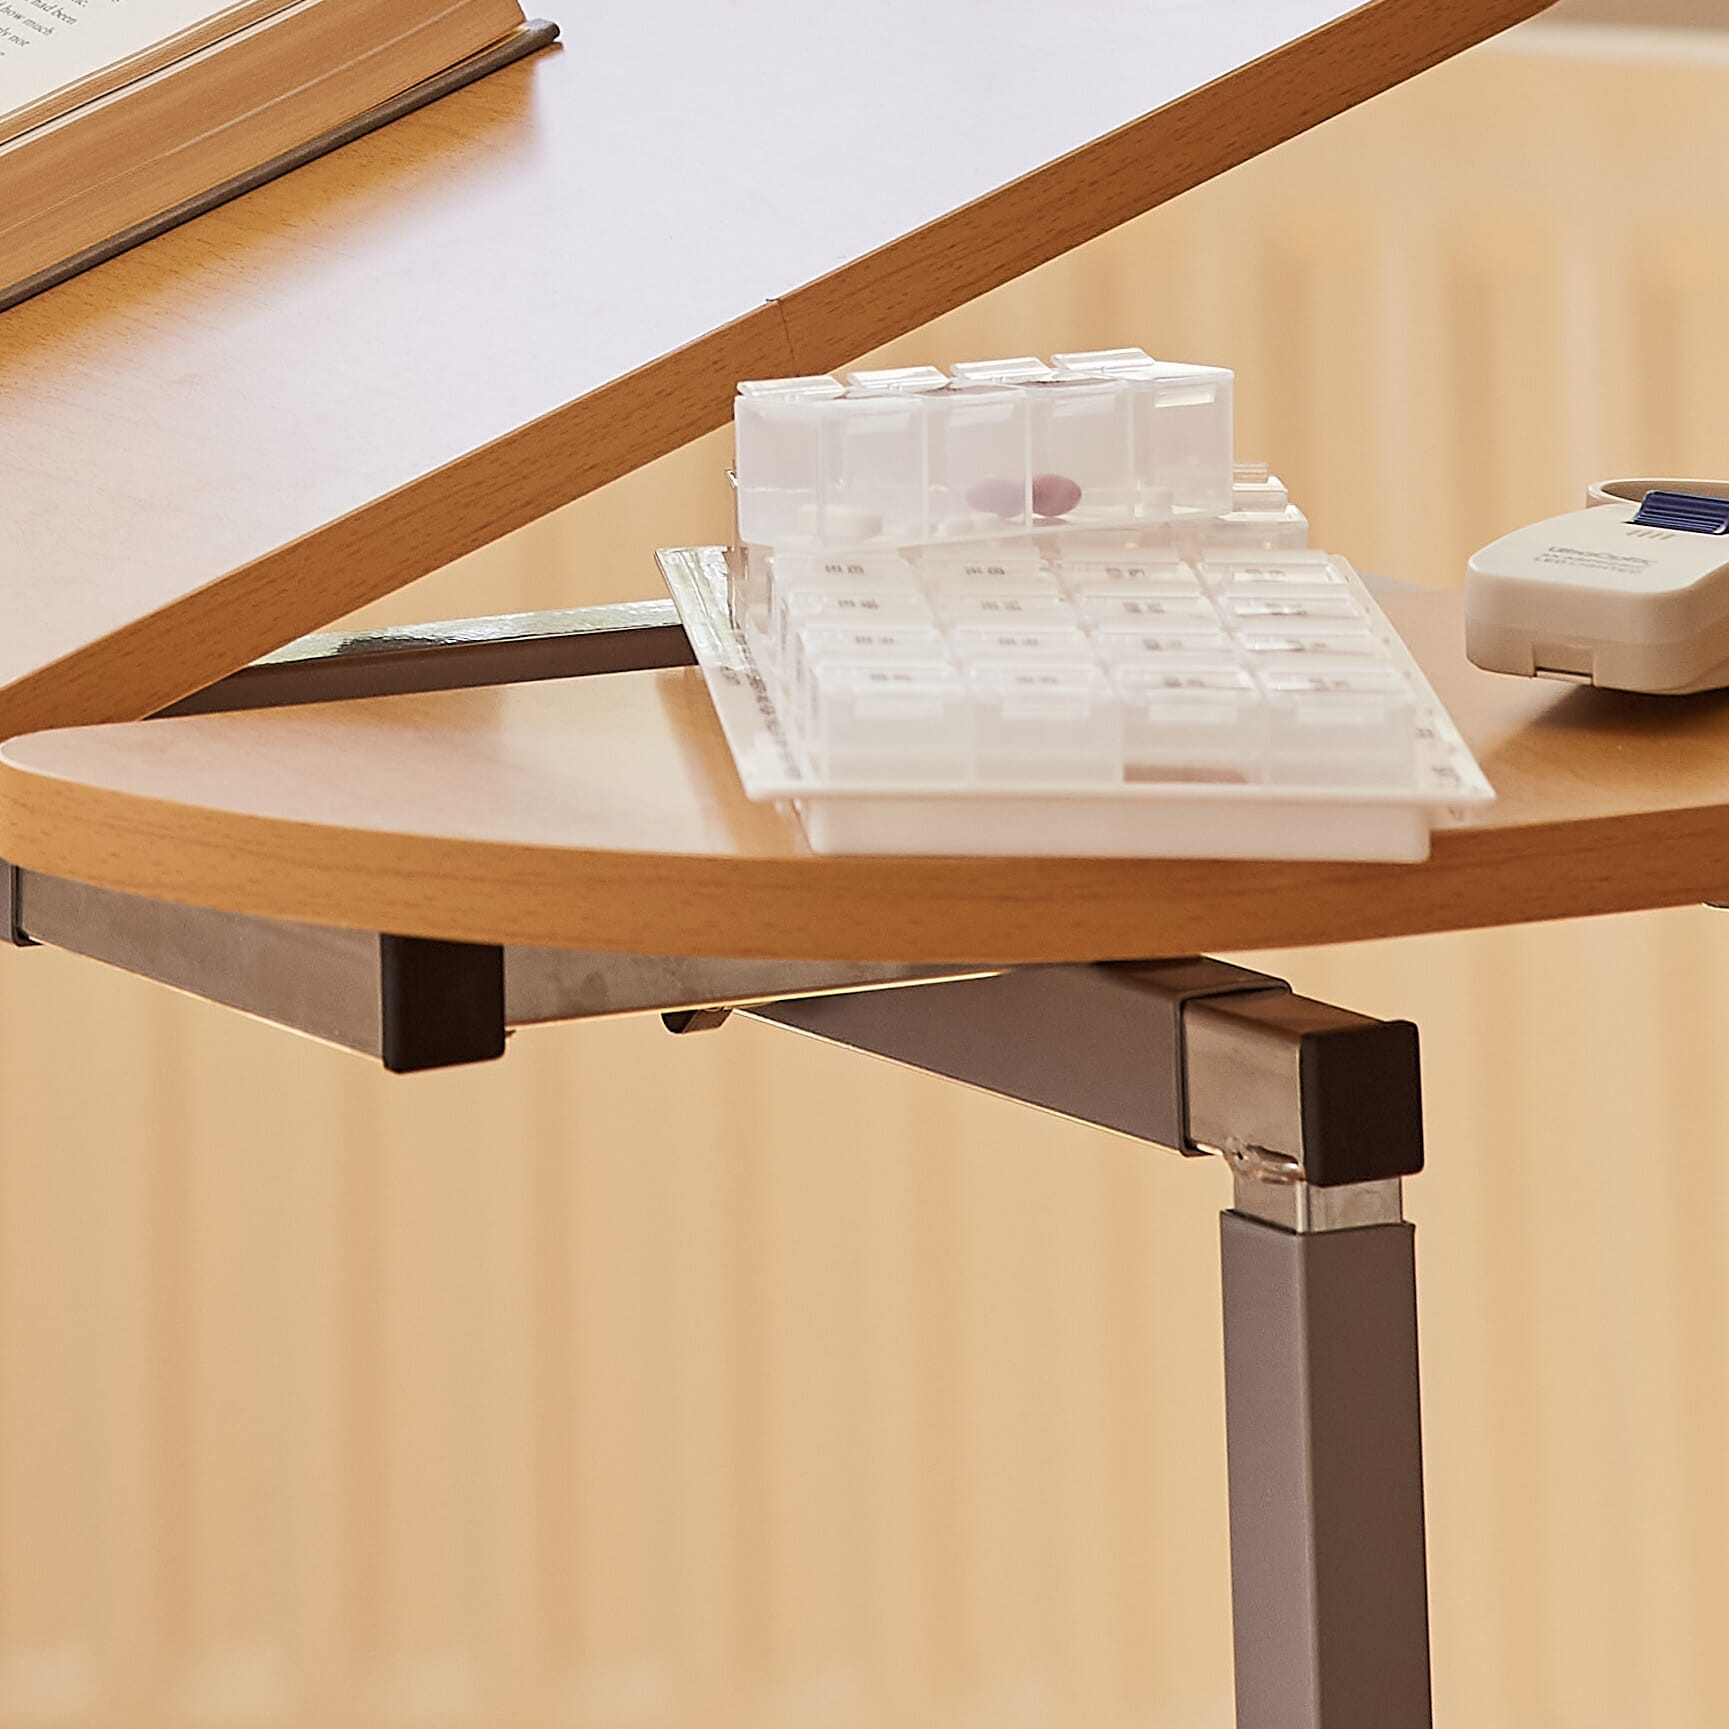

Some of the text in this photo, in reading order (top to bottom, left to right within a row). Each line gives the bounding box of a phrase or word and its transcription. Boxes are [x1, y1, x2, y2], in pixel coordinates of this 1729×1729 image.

[0, 5, 53, 35] how much
[51, 7, 76, 24] been
[8, 35, 29, 46] not
